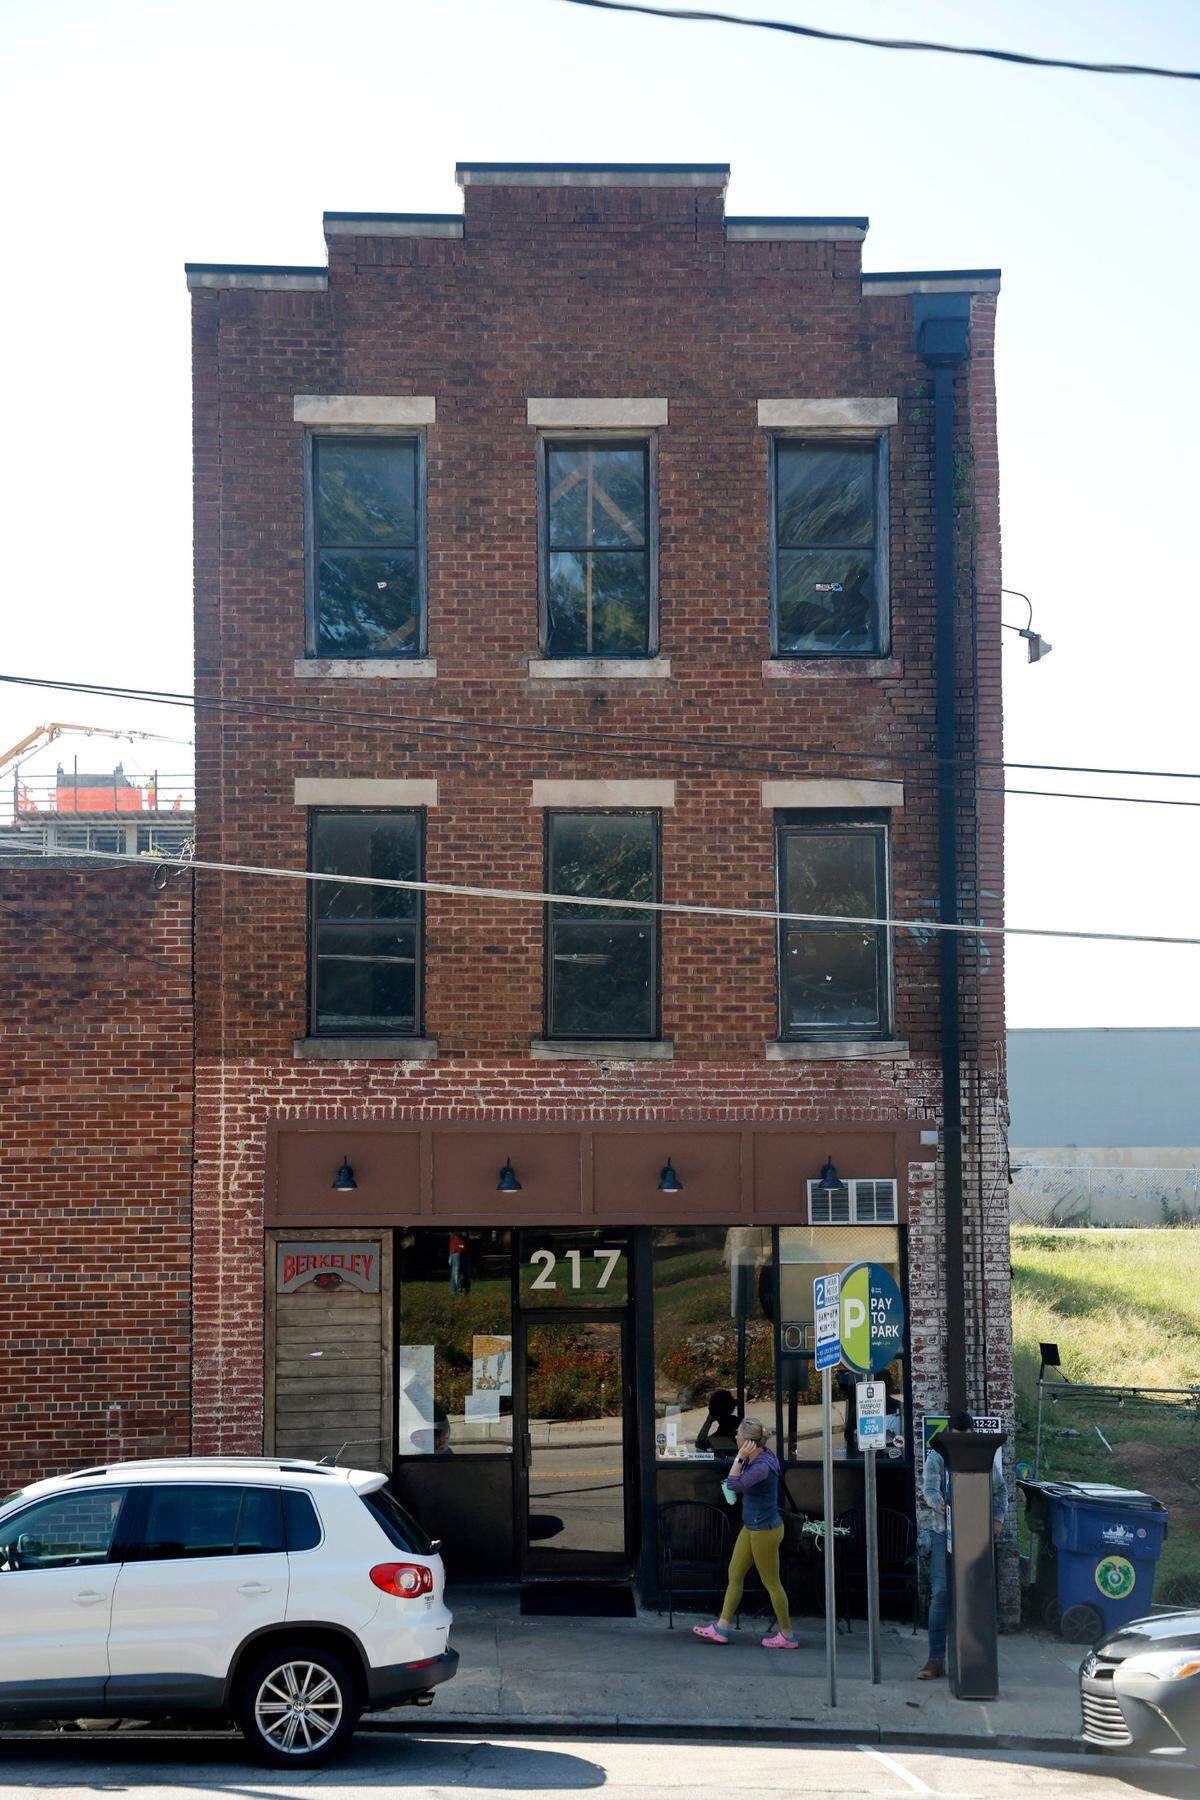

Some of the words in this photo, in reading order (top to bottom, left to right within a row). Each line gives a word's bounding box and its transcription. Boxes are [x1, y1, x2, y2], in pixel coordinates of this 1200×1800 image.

[283, 1253, 374, 1285] BERKELEY
[530, 1249, 621, 1289] 217
[816, 1283, 824, 1305] 2
[870, 1298, 892, 1310] PAY
[844, 1298, 866, 1339] P
[871, 1312, 886, 1324] TO
[871, 1325, 900, 1338] PARK
